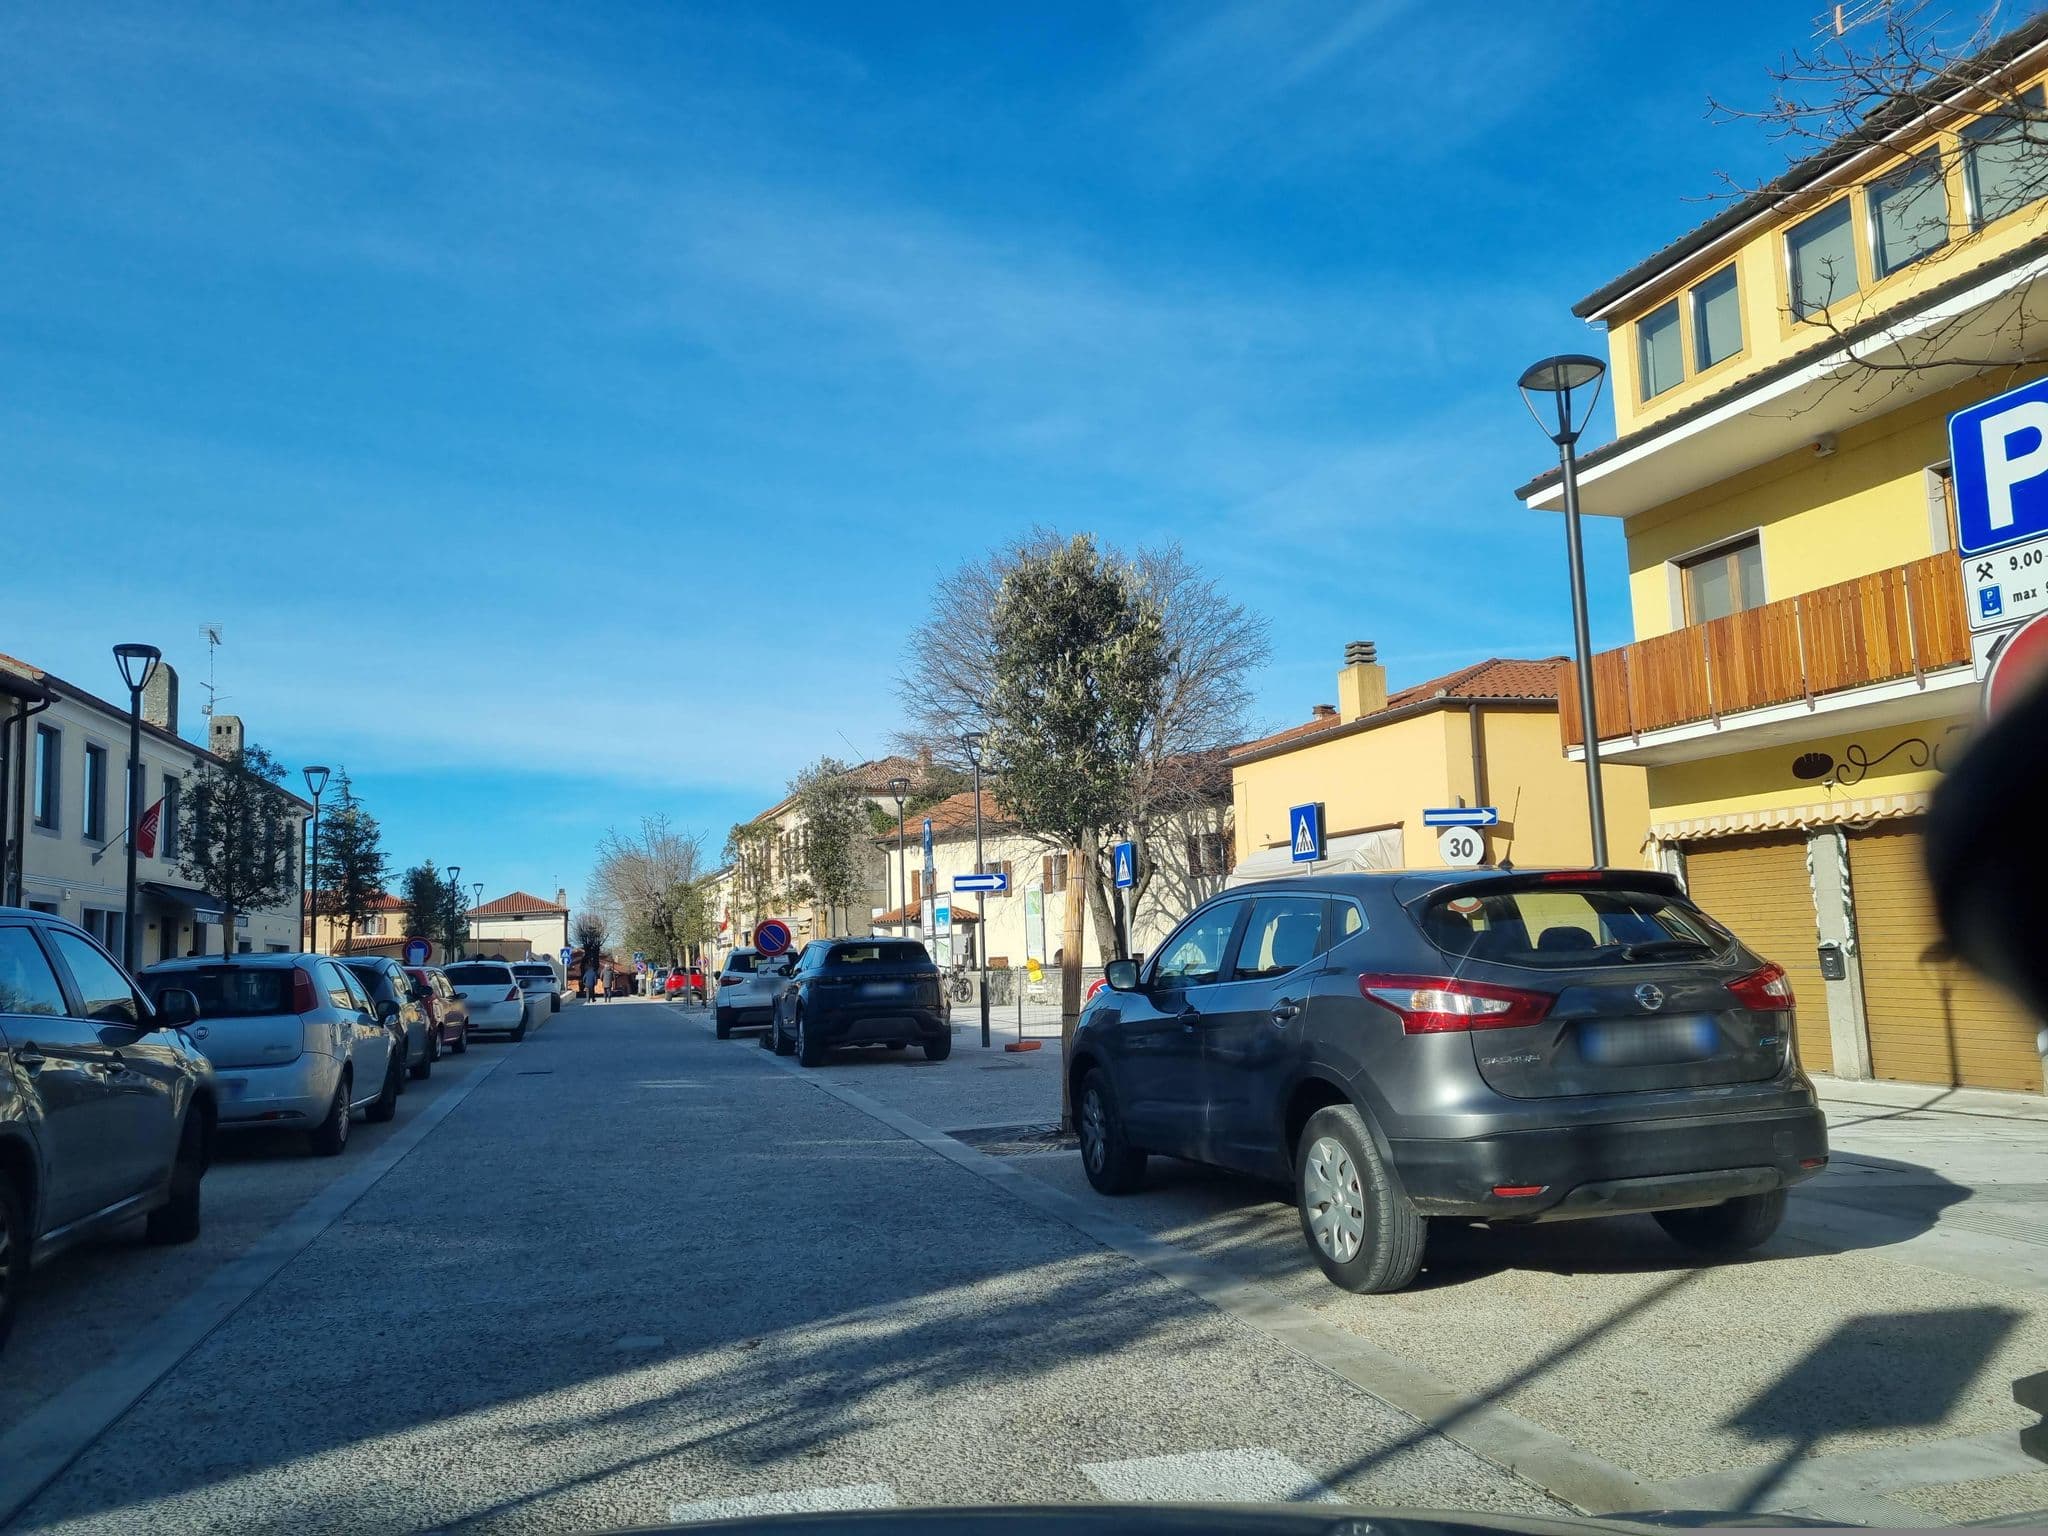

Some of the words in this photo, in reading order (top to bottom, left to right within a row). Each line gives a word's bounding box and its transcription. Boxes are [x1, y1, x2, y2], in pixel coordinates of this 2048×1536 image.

[1980, 401, 2048, 530] P
[2013, 588, 2037, 602] max
[1450, 838, 1474, 858] 30
